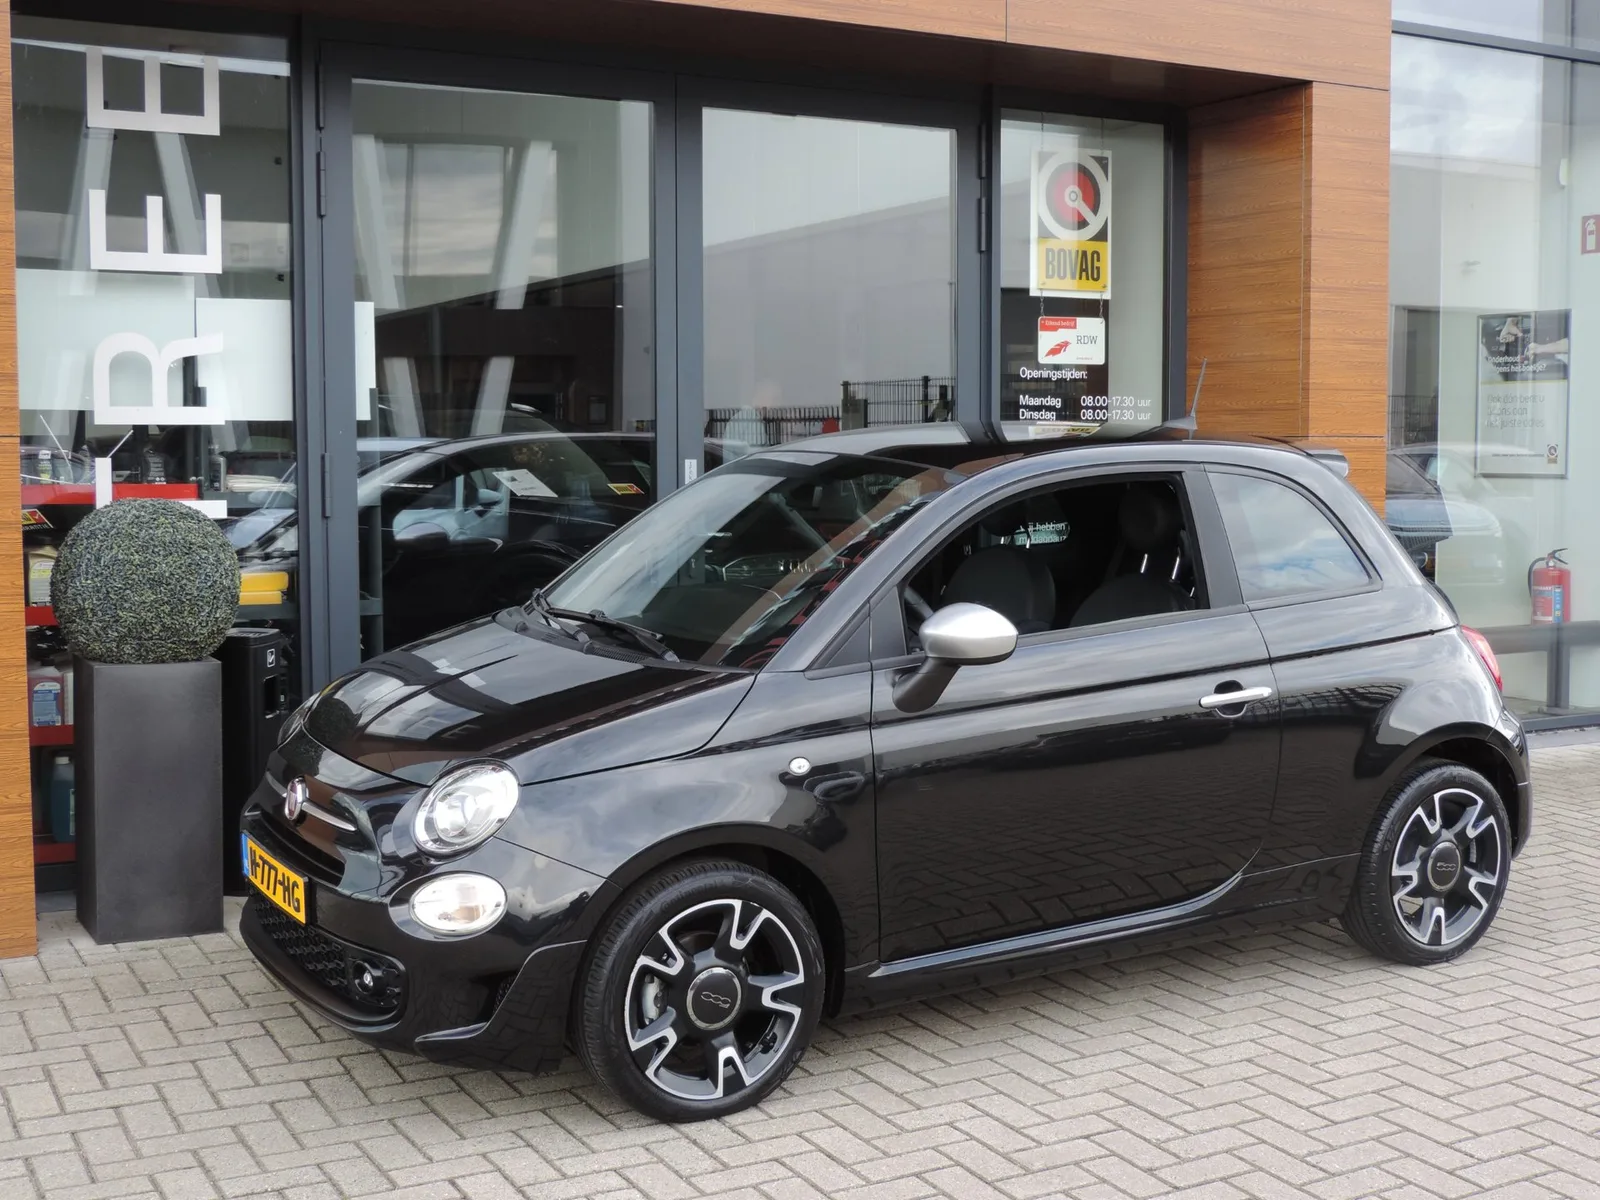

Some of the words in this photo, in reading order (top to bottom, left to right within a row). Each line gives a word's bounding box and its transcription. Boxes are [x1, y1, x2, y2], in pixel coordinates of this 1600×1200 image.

[1045, 247, 1101, 282] BOVAG
[1076, 335, 1098, 345] RDW
[1019, 366, 1088, 381] Openingstijden:
[1019, 394, 1062, 408] Maandag
[1080, 395, 1134, 407] 08.00-17.30
[1137, 398, 1151, 407] uur
[1019, 408, 1056, 421] Dinsdag
[1080, 409, 1134, 420] 08.00-17.30
[1137, 411, 1151, 420] uur
[1036, 522, 1066, 532] hebben
[249, 846, 302, 914] H-777-HG
